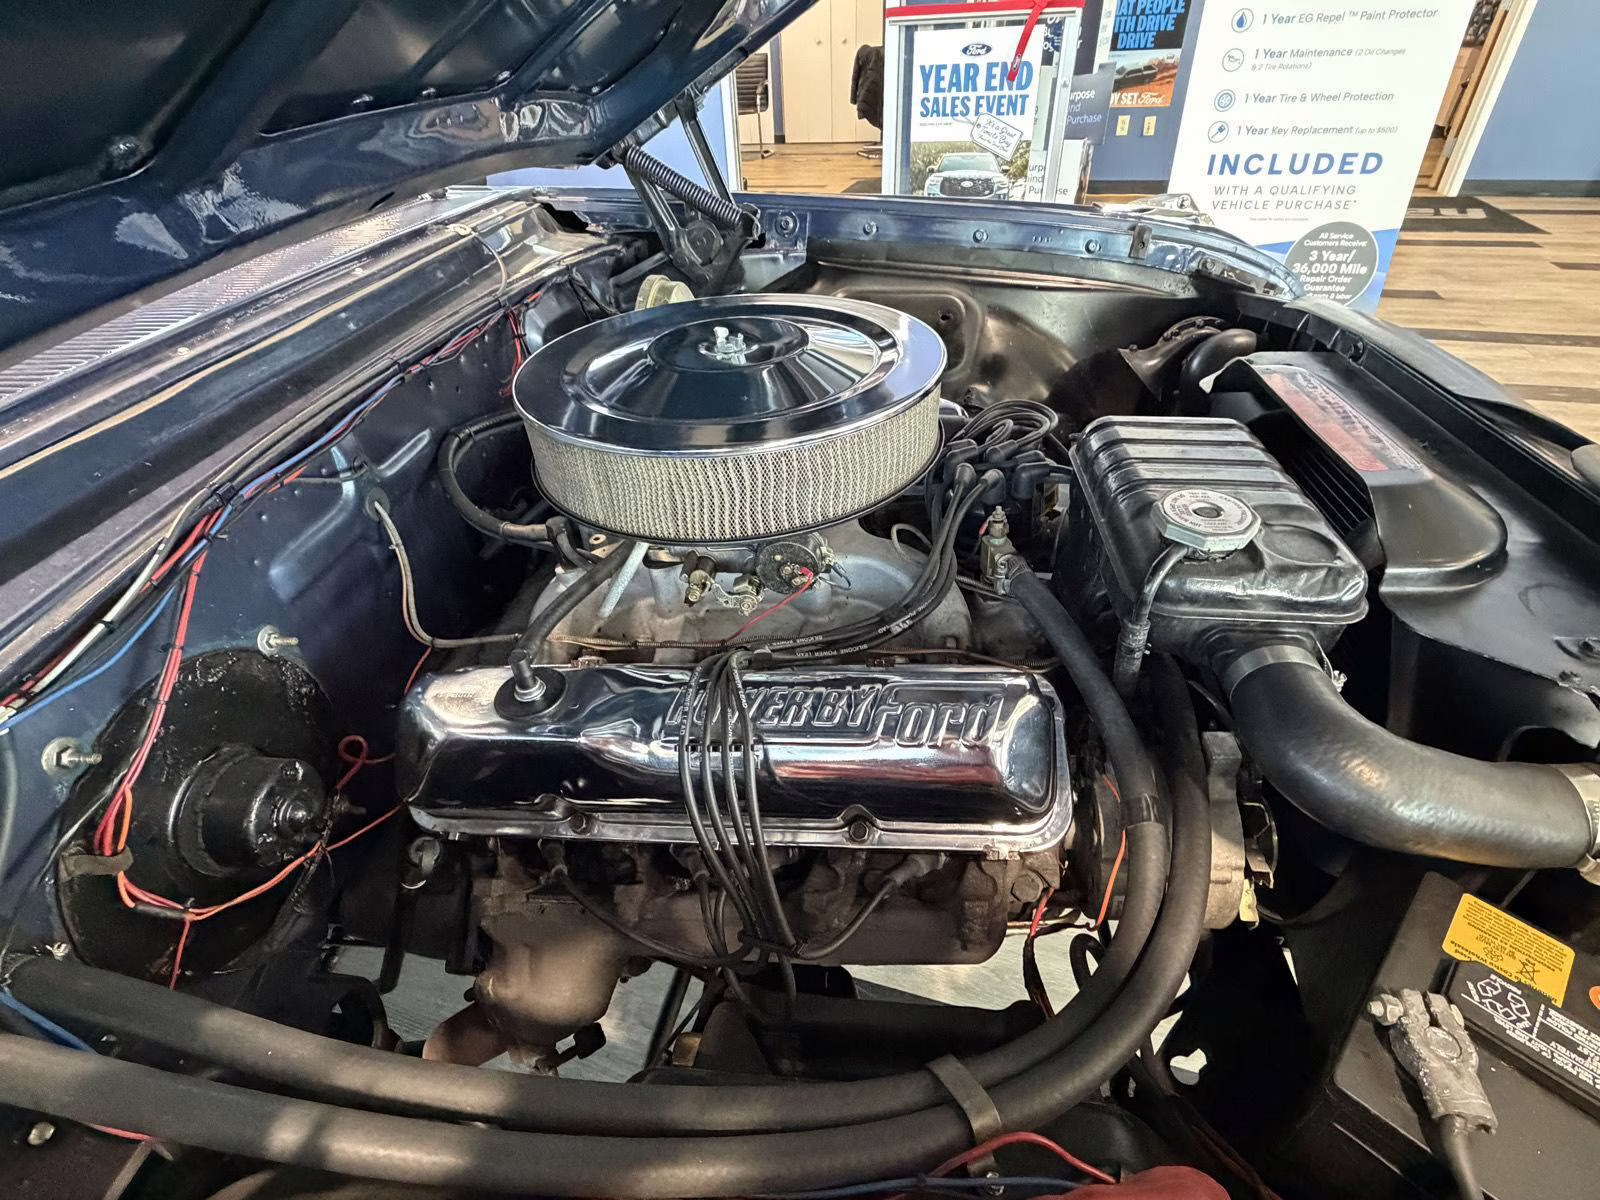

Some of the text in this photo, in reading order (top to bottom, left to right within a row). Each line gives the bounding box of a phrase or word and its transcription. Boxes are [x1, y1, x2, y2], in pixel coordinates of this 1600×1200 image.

[1115, 0, 1186, 16] AT PEOPLE
[1114, 14, 1177, 32] ITH DRIVE
[1263, 14, 1267, 24] 1
[1271, 13, 1296, 24] Year
[1298, 13, 1314, 23] EG
[1316, 11, 1345, 24] Repel
[1360, 10, 1386, 21] Paint
[1388, 9, 1438, 19] Protector
[1117, 32, 1156, 49] DRIVE
[964, 44, 990, 56] Ford
[1255, 49, 1259, 59] 1
[1263, 48, 1288, 59] Year
[1289, 48, 1353, 58] Maintenance
[919, 63, 979, 93] YEAR
[985, 61, 1034, 91] END
[1121, 92, 1139, 105] SET
[1138, 91, 1168, 104] Ford
[1245, 91, 1394, 104] 1 Year Tire & Wheel Protection
[920, 96, 971, 117] SALES
[975, 94, 1029, 117] EVENT
[1067, 113, 1102, 125] Purchase
[1237, 126, 1242, 135] 1
[1245, 126, 1269, 135] Year
[1271, 126, 1289, 136] Key
[1291, 125, 1353, 136] Replacement
[1206, 152, 1384, 176] INCLUDED
[1214, 184, 1357, 195] WITH A QUALIFYING
[1212, 200, 1270, 210] VEHICLE
[1329, 232, 1354, 240] Service
[1309, 249, 1357, 263] 3 Year/
[1292, 262, 1368, 275] 36,000 Mile
[1300, 275, 1352, 283] Repair Order
[1303, 284, 1346, 292] Guarantee
[813, 648, 837, 656] POWER
[682, 688, 691, 711] POWER
[738, 690, 747, 708] LEAD
[867, 683, 1004, 749] Ford
[1449, 939, 1488, 963] Wholesale
